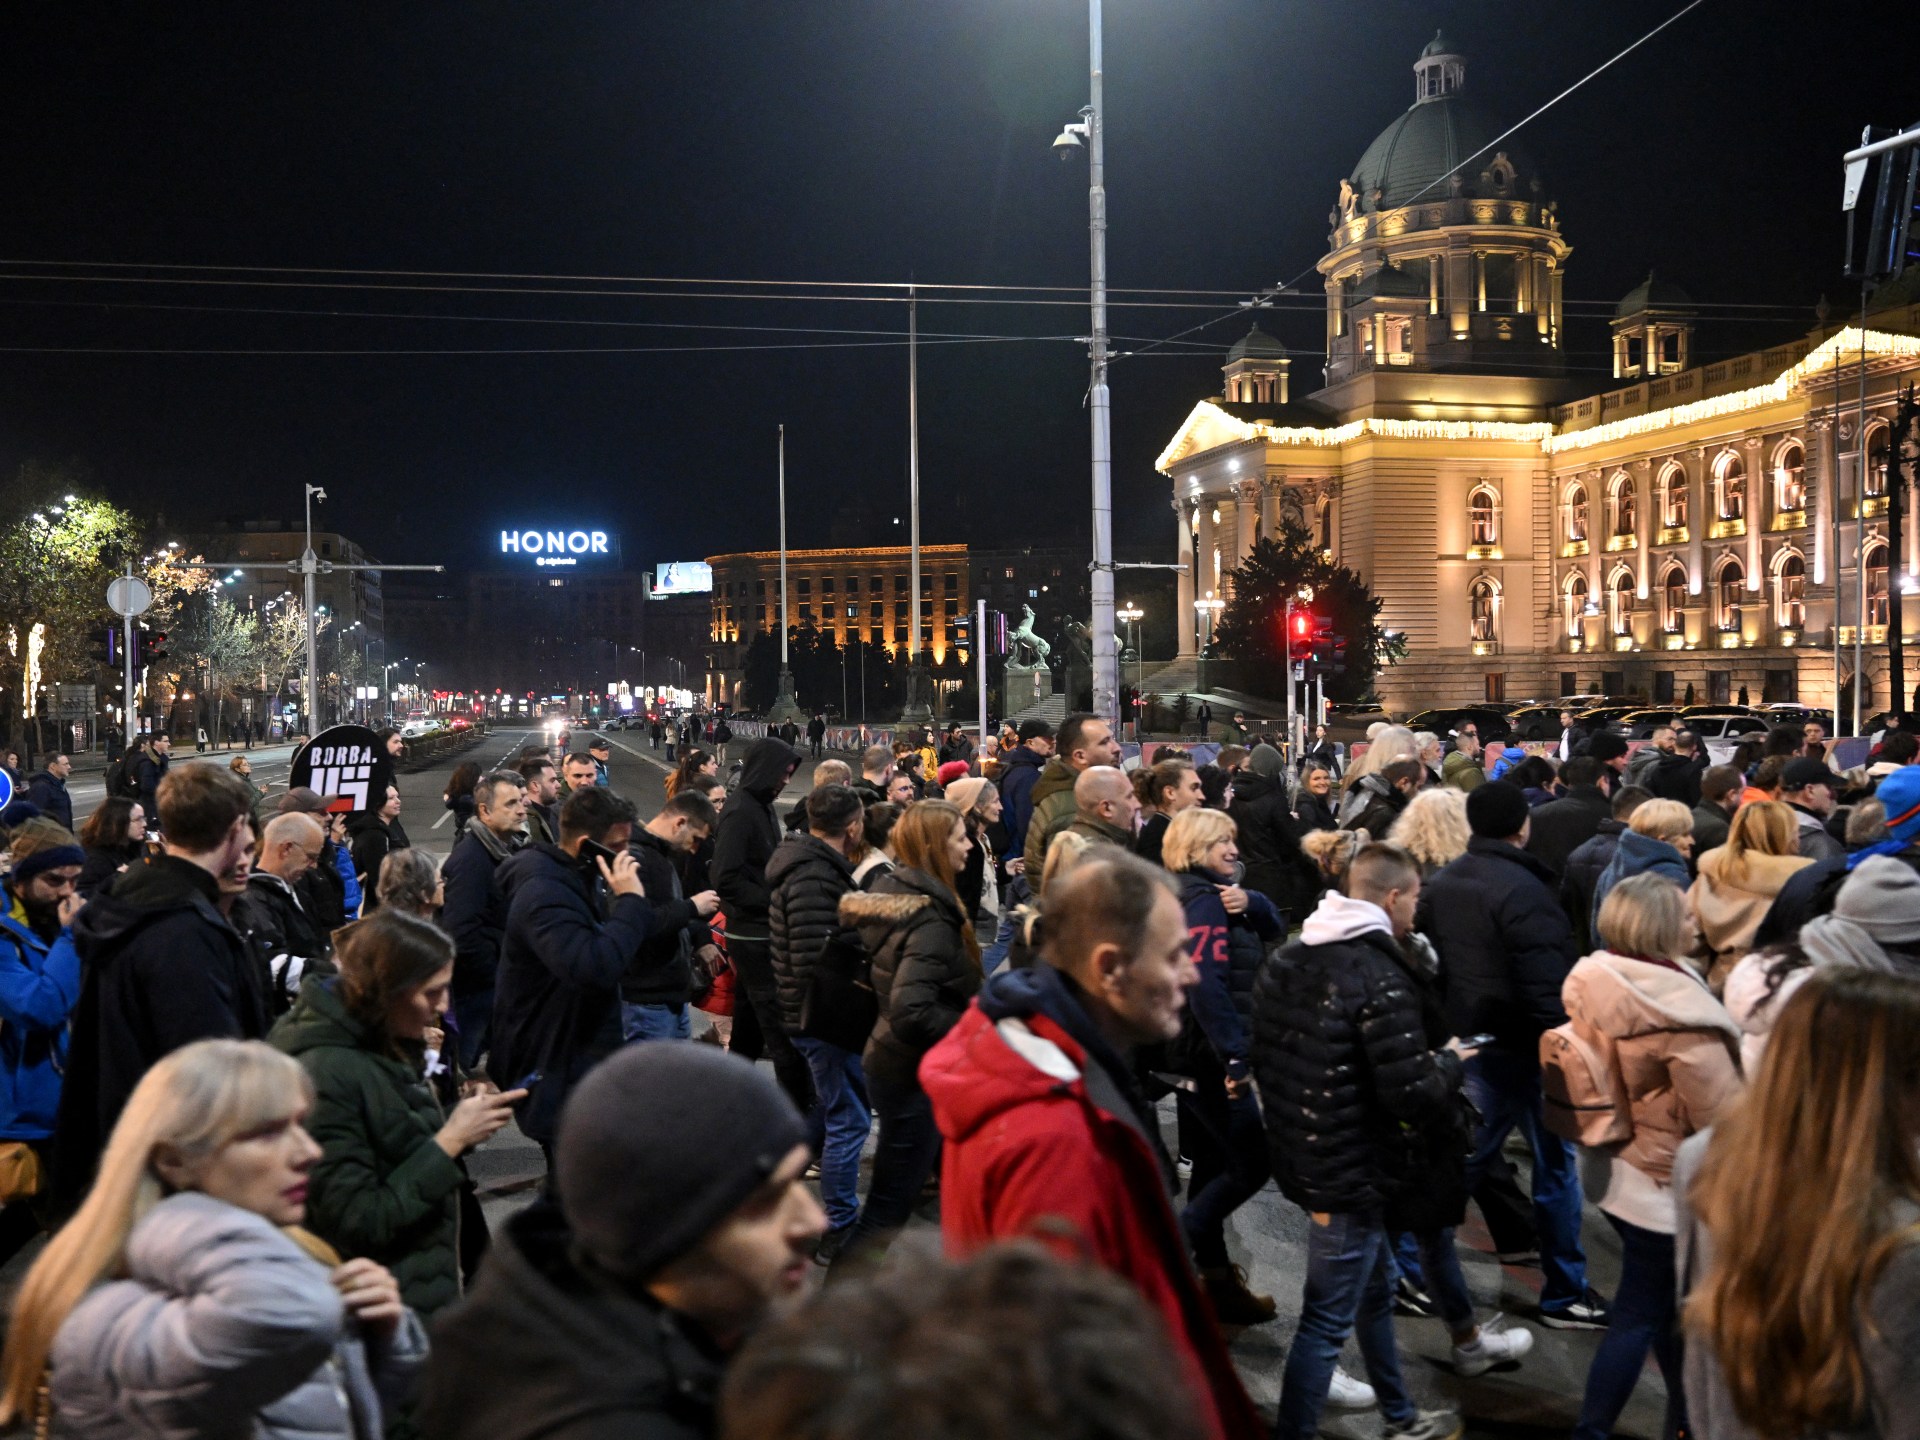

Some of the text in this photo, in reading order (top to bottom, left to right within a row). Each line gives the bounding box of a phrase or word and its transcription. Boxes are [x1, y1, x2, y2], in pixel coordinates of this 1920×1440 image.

[502, 531, 609, 553] HONOR
[310, 745, 378, 767] BORBA.
[1188, 925, 1229, 963] 72
